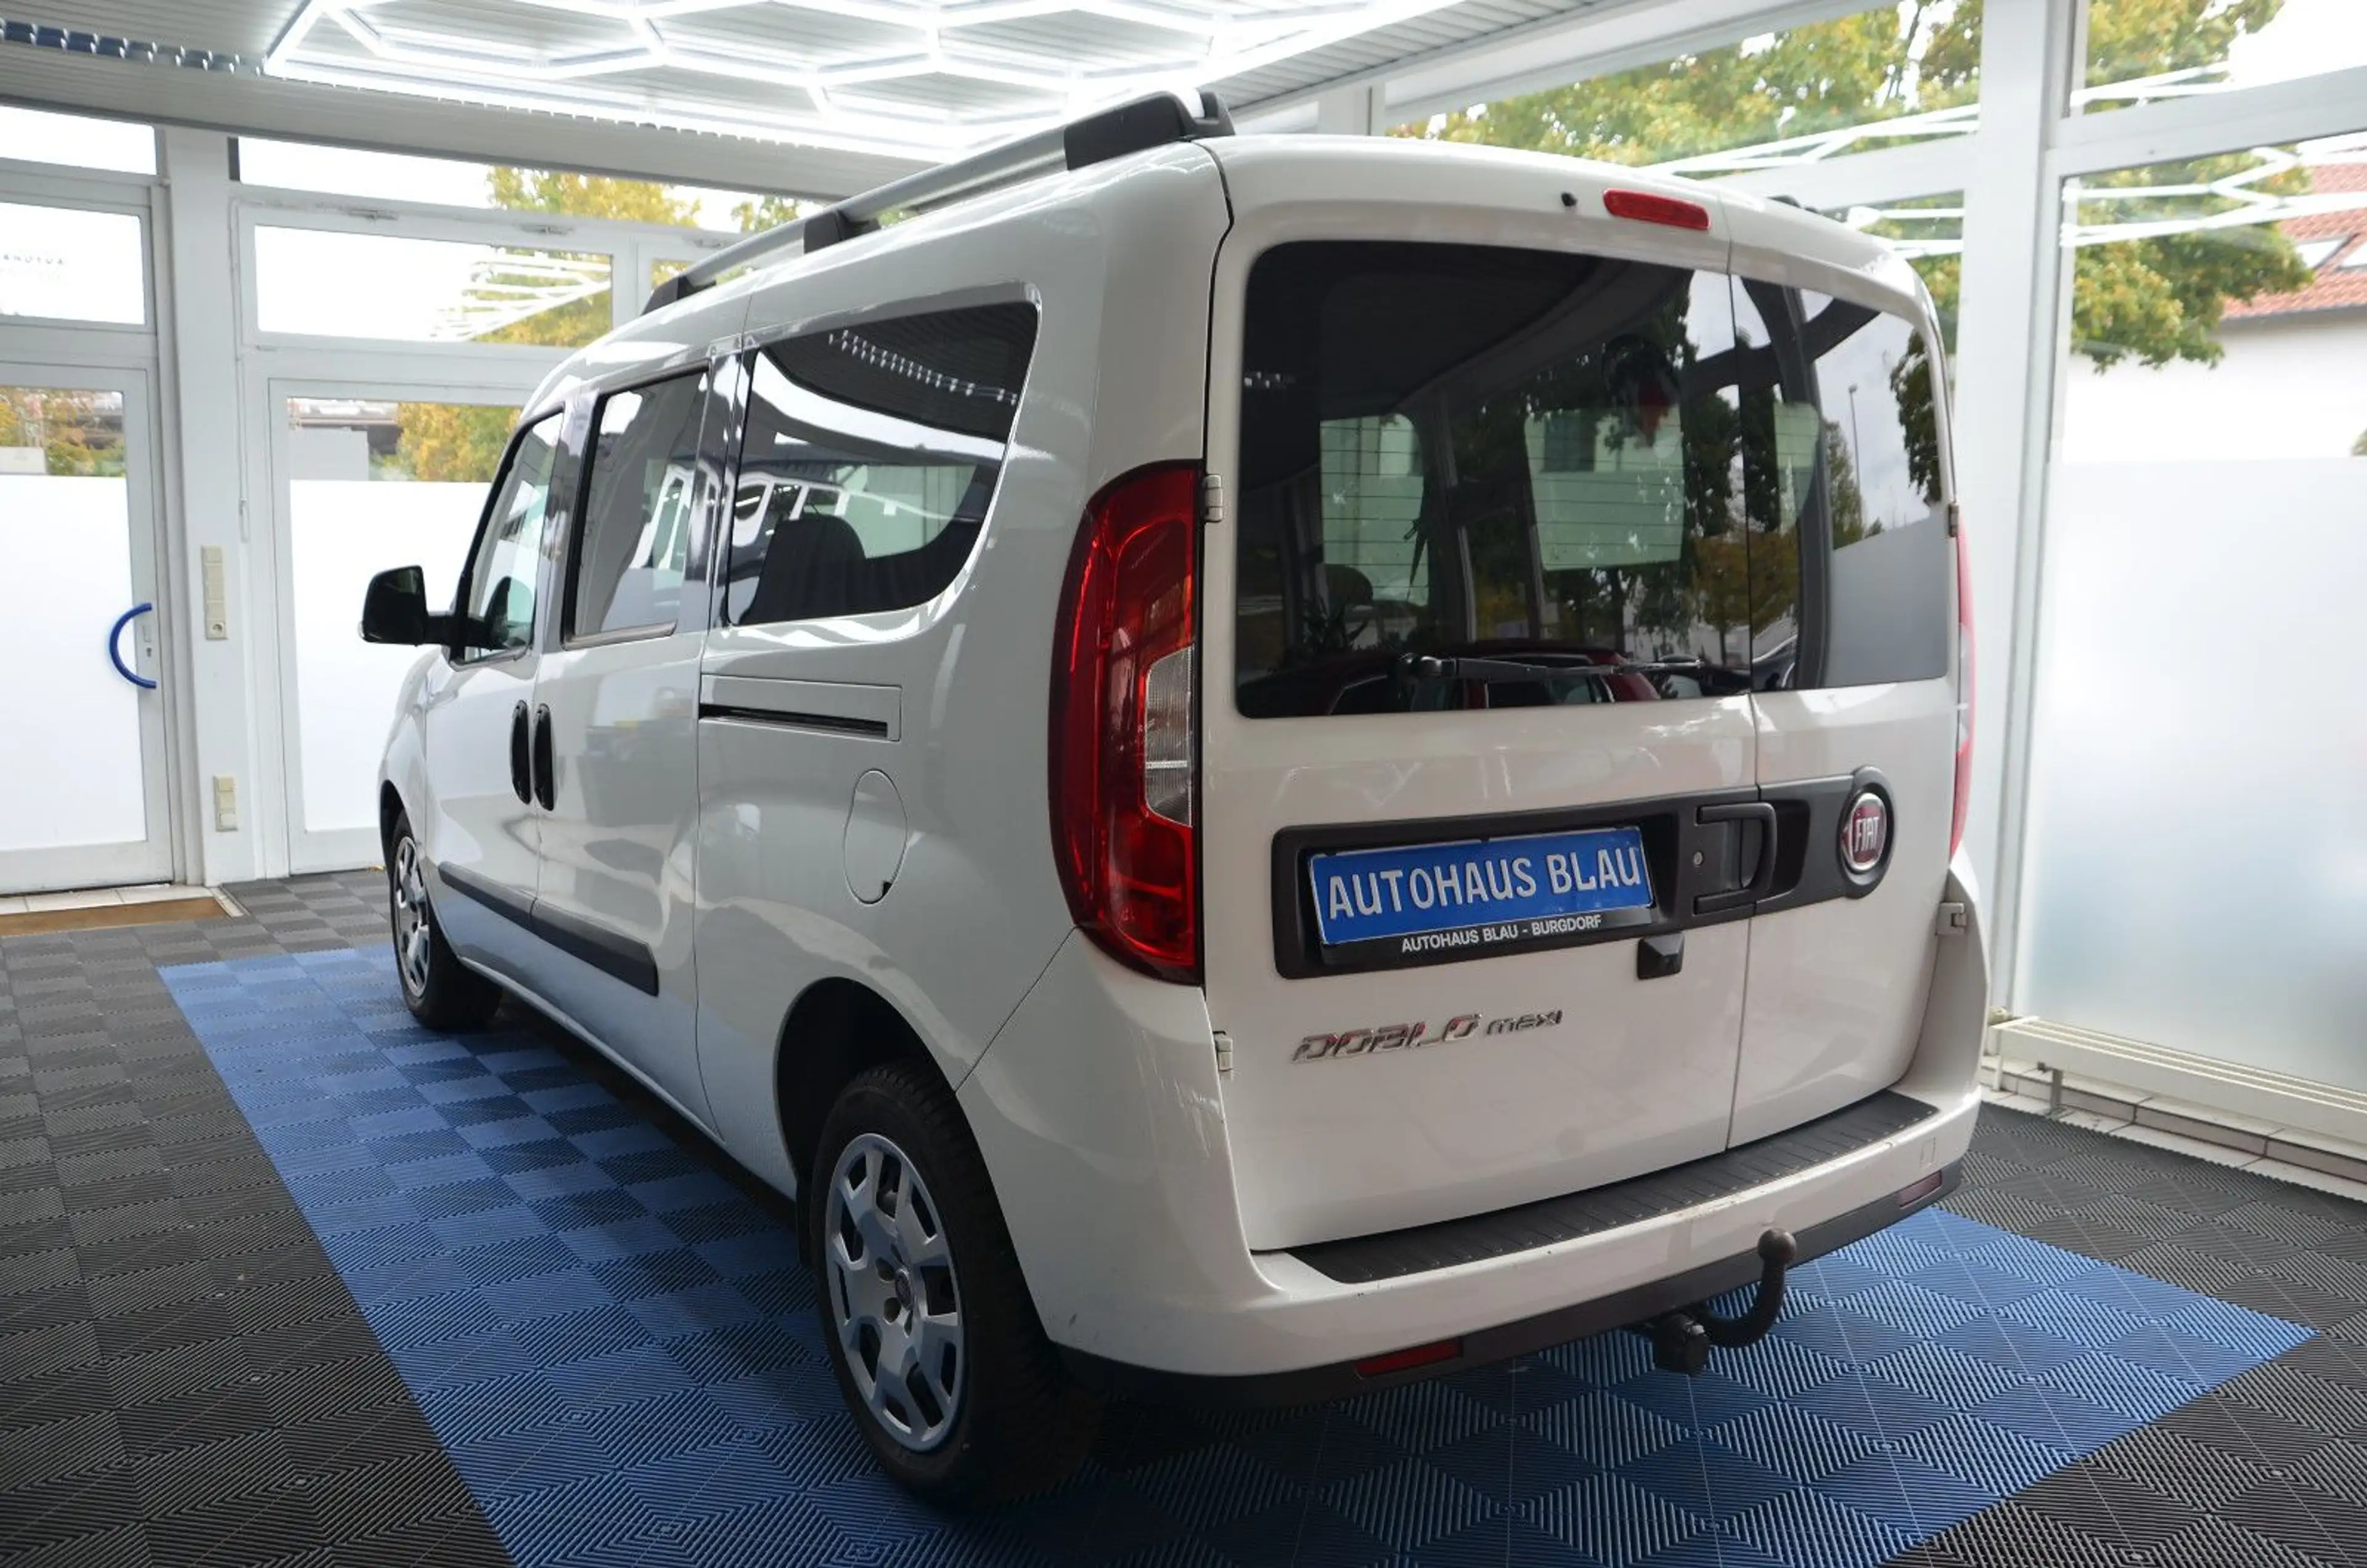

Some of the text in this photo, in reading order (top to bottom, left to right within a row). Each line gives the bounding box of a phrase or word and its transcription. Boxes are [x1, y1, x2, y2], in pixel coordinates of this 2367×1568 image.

[1855, 816, 1879, 852] FIAT
[1329, 846, 1641, 920] AUTOHAUS BLAU
[1401, 930, 1479, 952] AUTOHAUS
[1482, 925, 1518, 941] BLAU
[1531, 915, 1601, 936] BURGDORF
